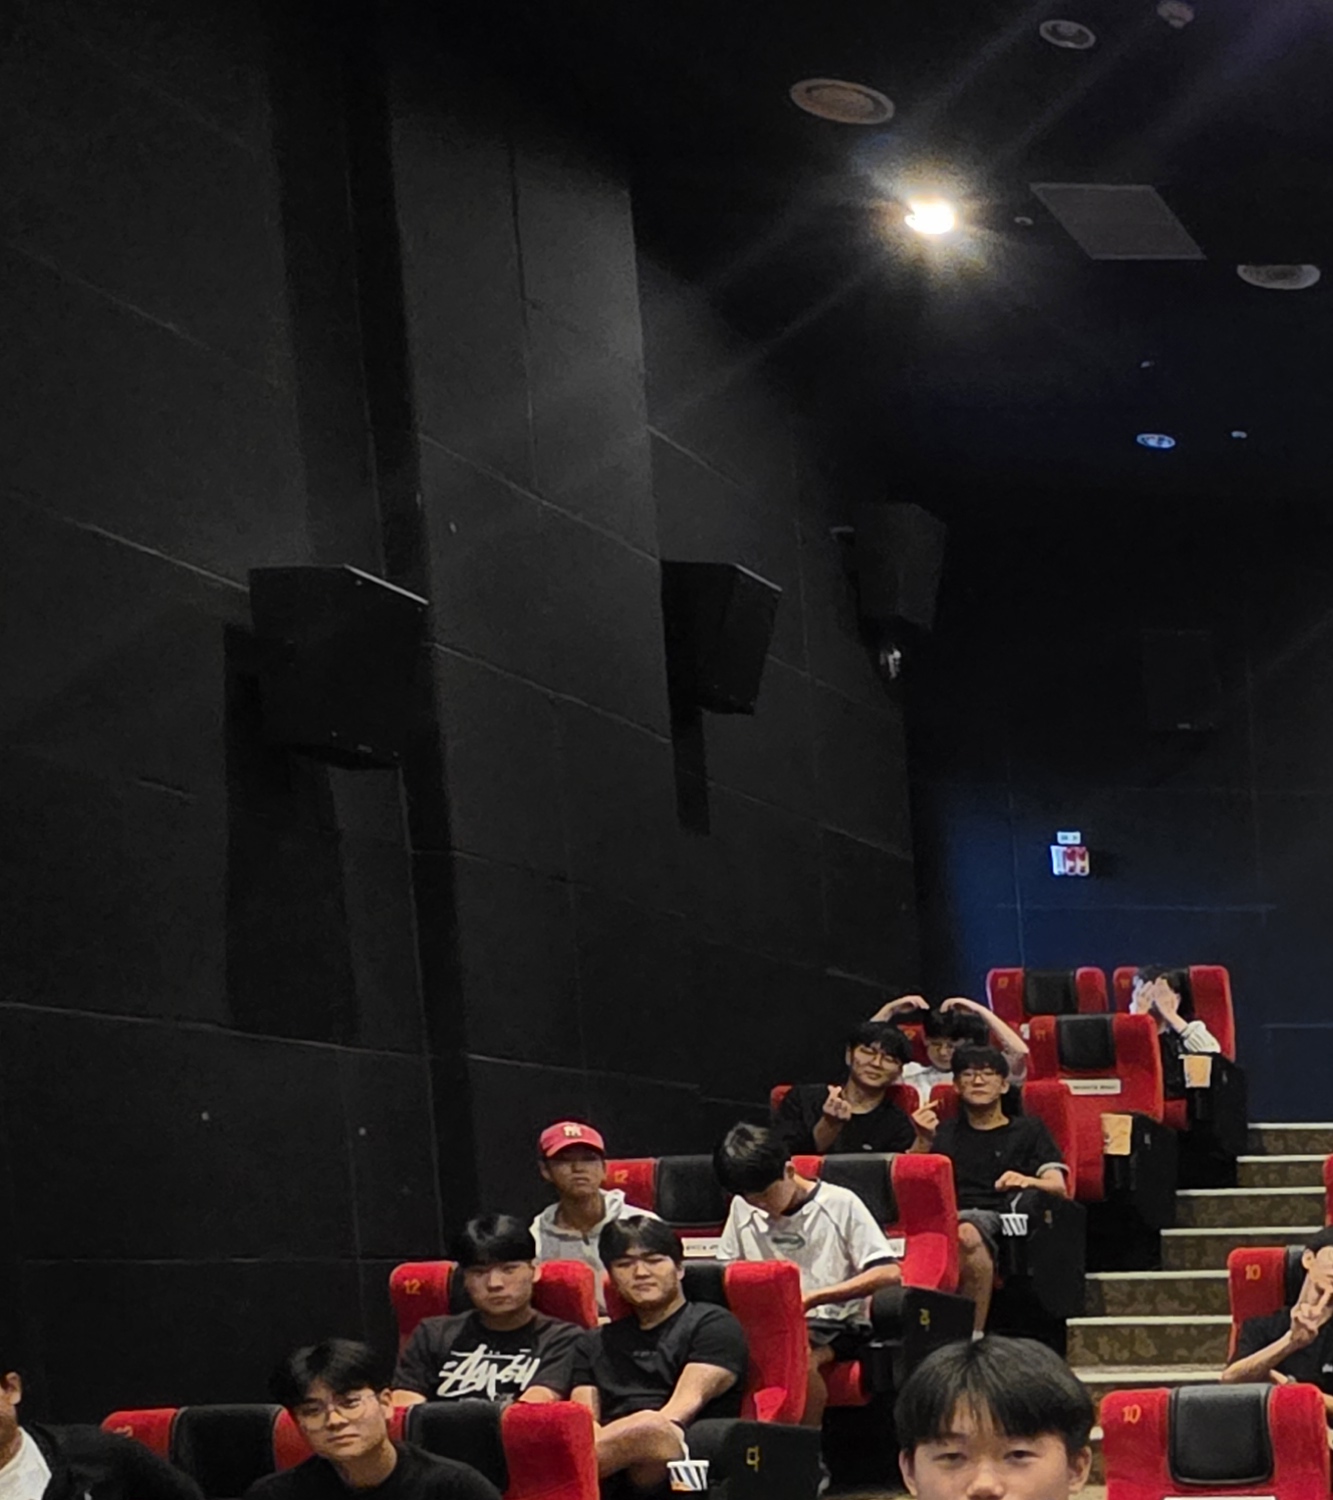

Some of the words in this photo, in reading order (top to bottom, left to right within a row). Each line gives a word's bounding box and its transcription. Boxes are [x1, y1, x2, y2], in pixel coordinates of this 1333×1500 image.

[1245, 1264, 1261, 1281] 10
[404, 1278, 421, 1295] 12
[1122, 1404, 1142, 1424] 10
